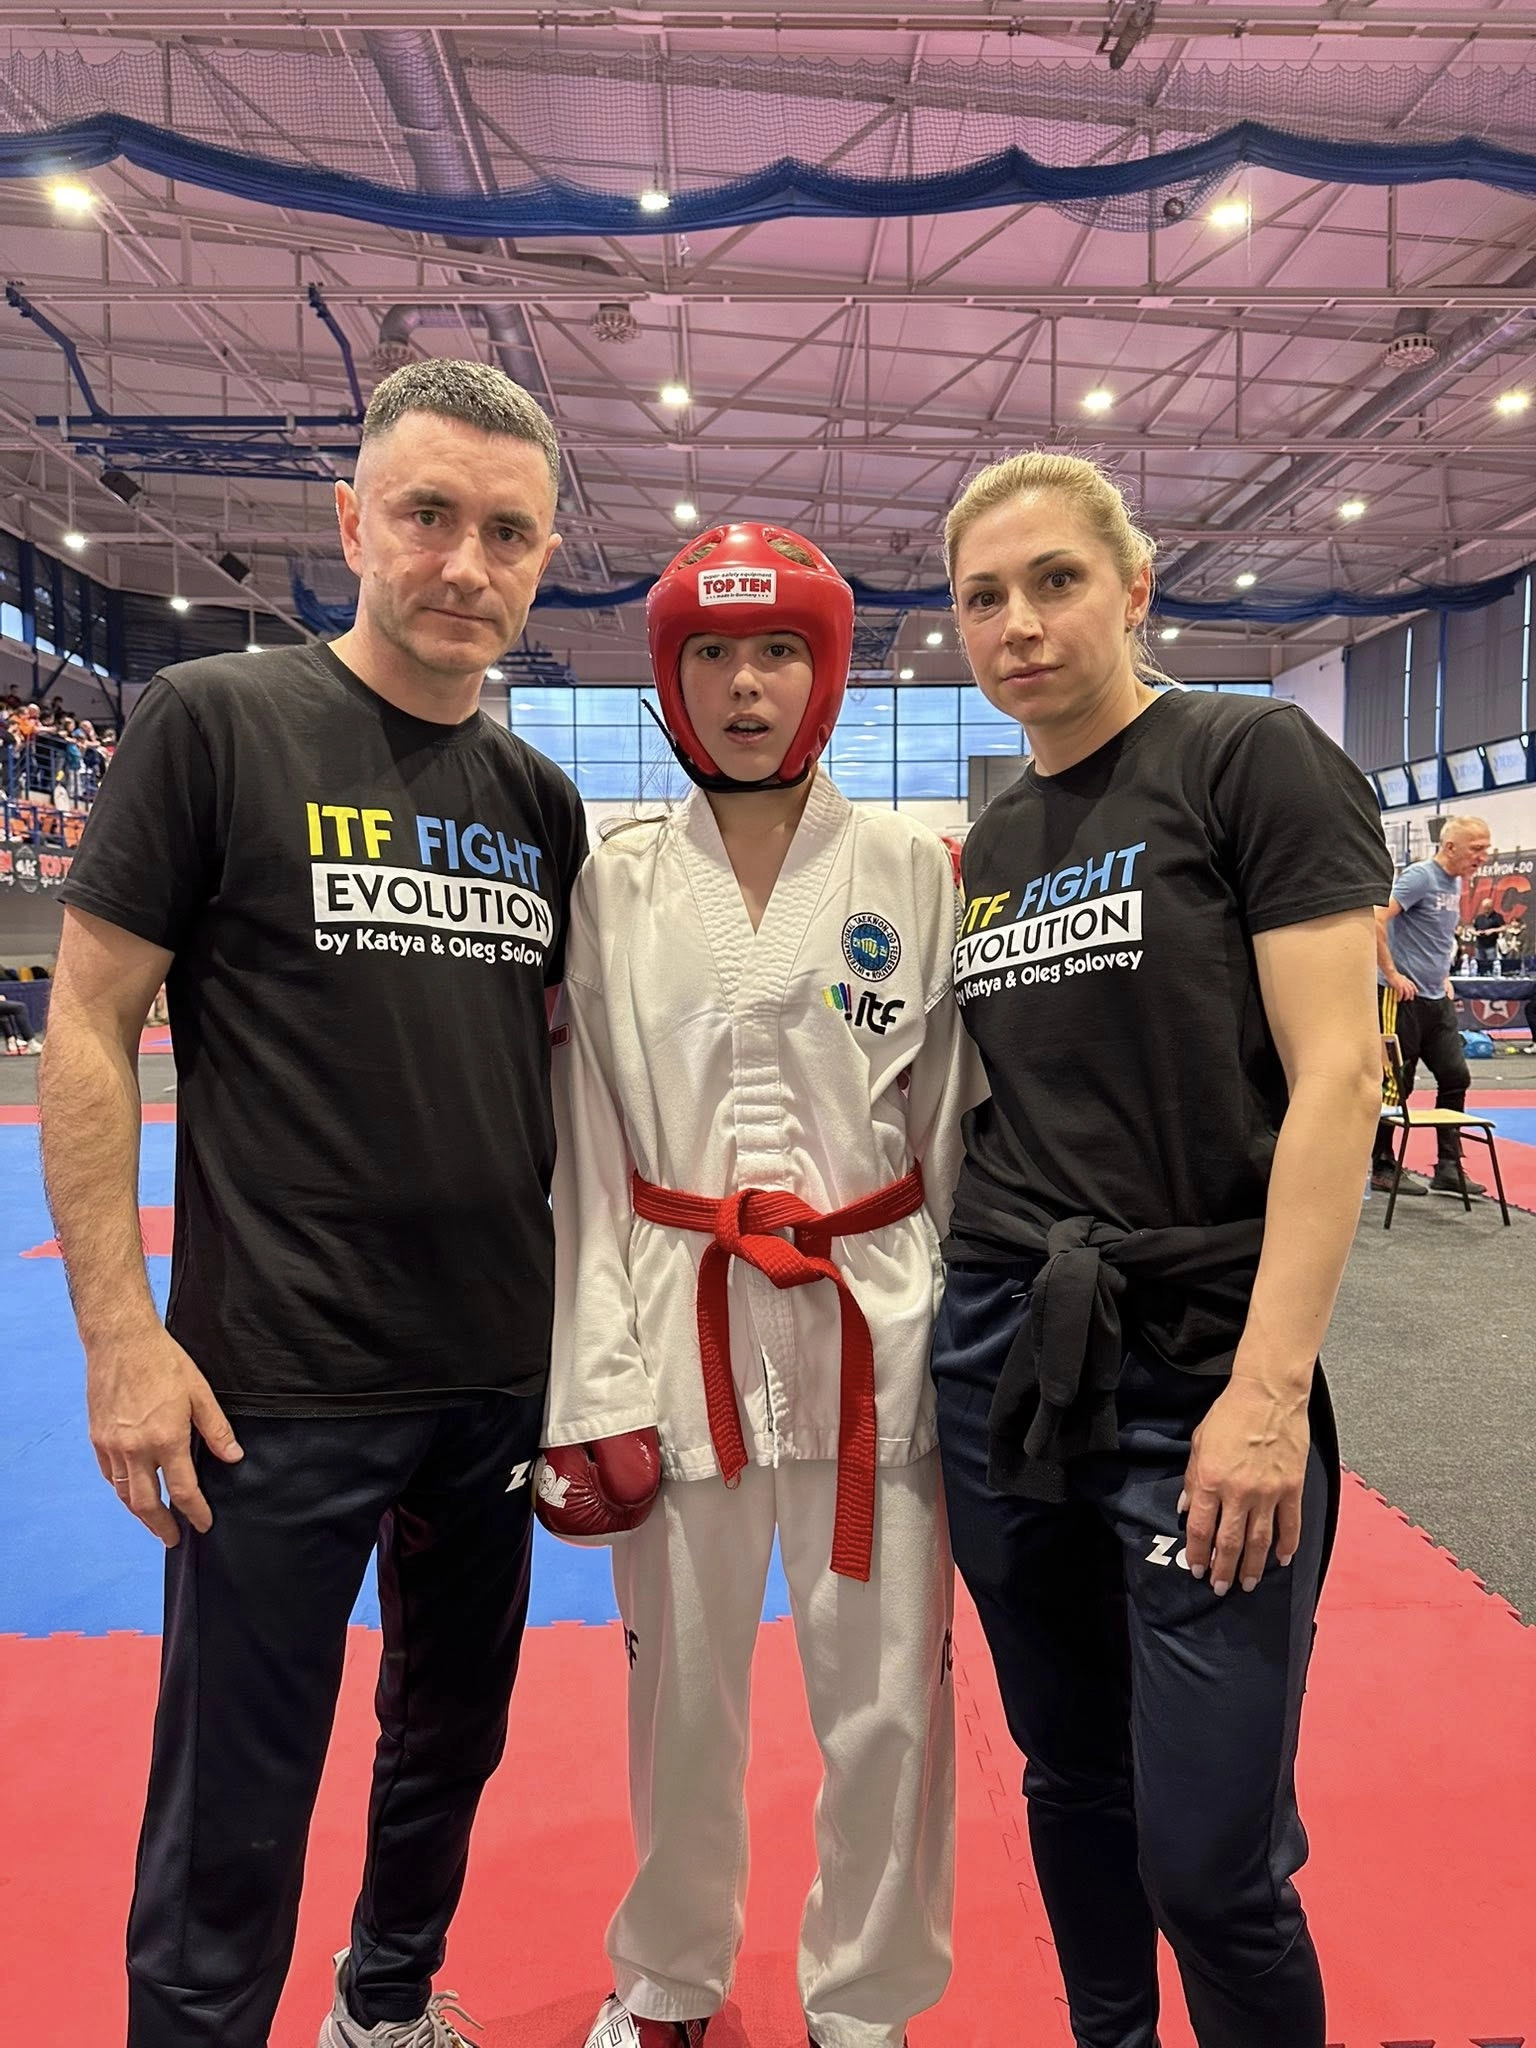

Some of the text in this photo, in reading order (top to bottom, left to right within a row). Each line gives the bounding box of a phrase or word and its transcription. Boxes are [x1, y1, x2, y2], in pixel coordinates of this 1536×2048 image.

[703, 578, 772, 594] TOP TEN
[306, 802, 543, 891] ITF FIGHT
[327, 873, 549, 938] EVOLUTION
[1016, 841, 1147, 920] FIGHT
[315, 928, 544, 967] by Katya & Oleg Solov
[956, 900, 1130, 975] EVOLUTION
[964, 976, 1002, 1000] Katya
[1005, 970, 1017, 990] &
[1020, 963, 1061, 984] Oleg
[1064, 950, 1144, 977] Solovey
